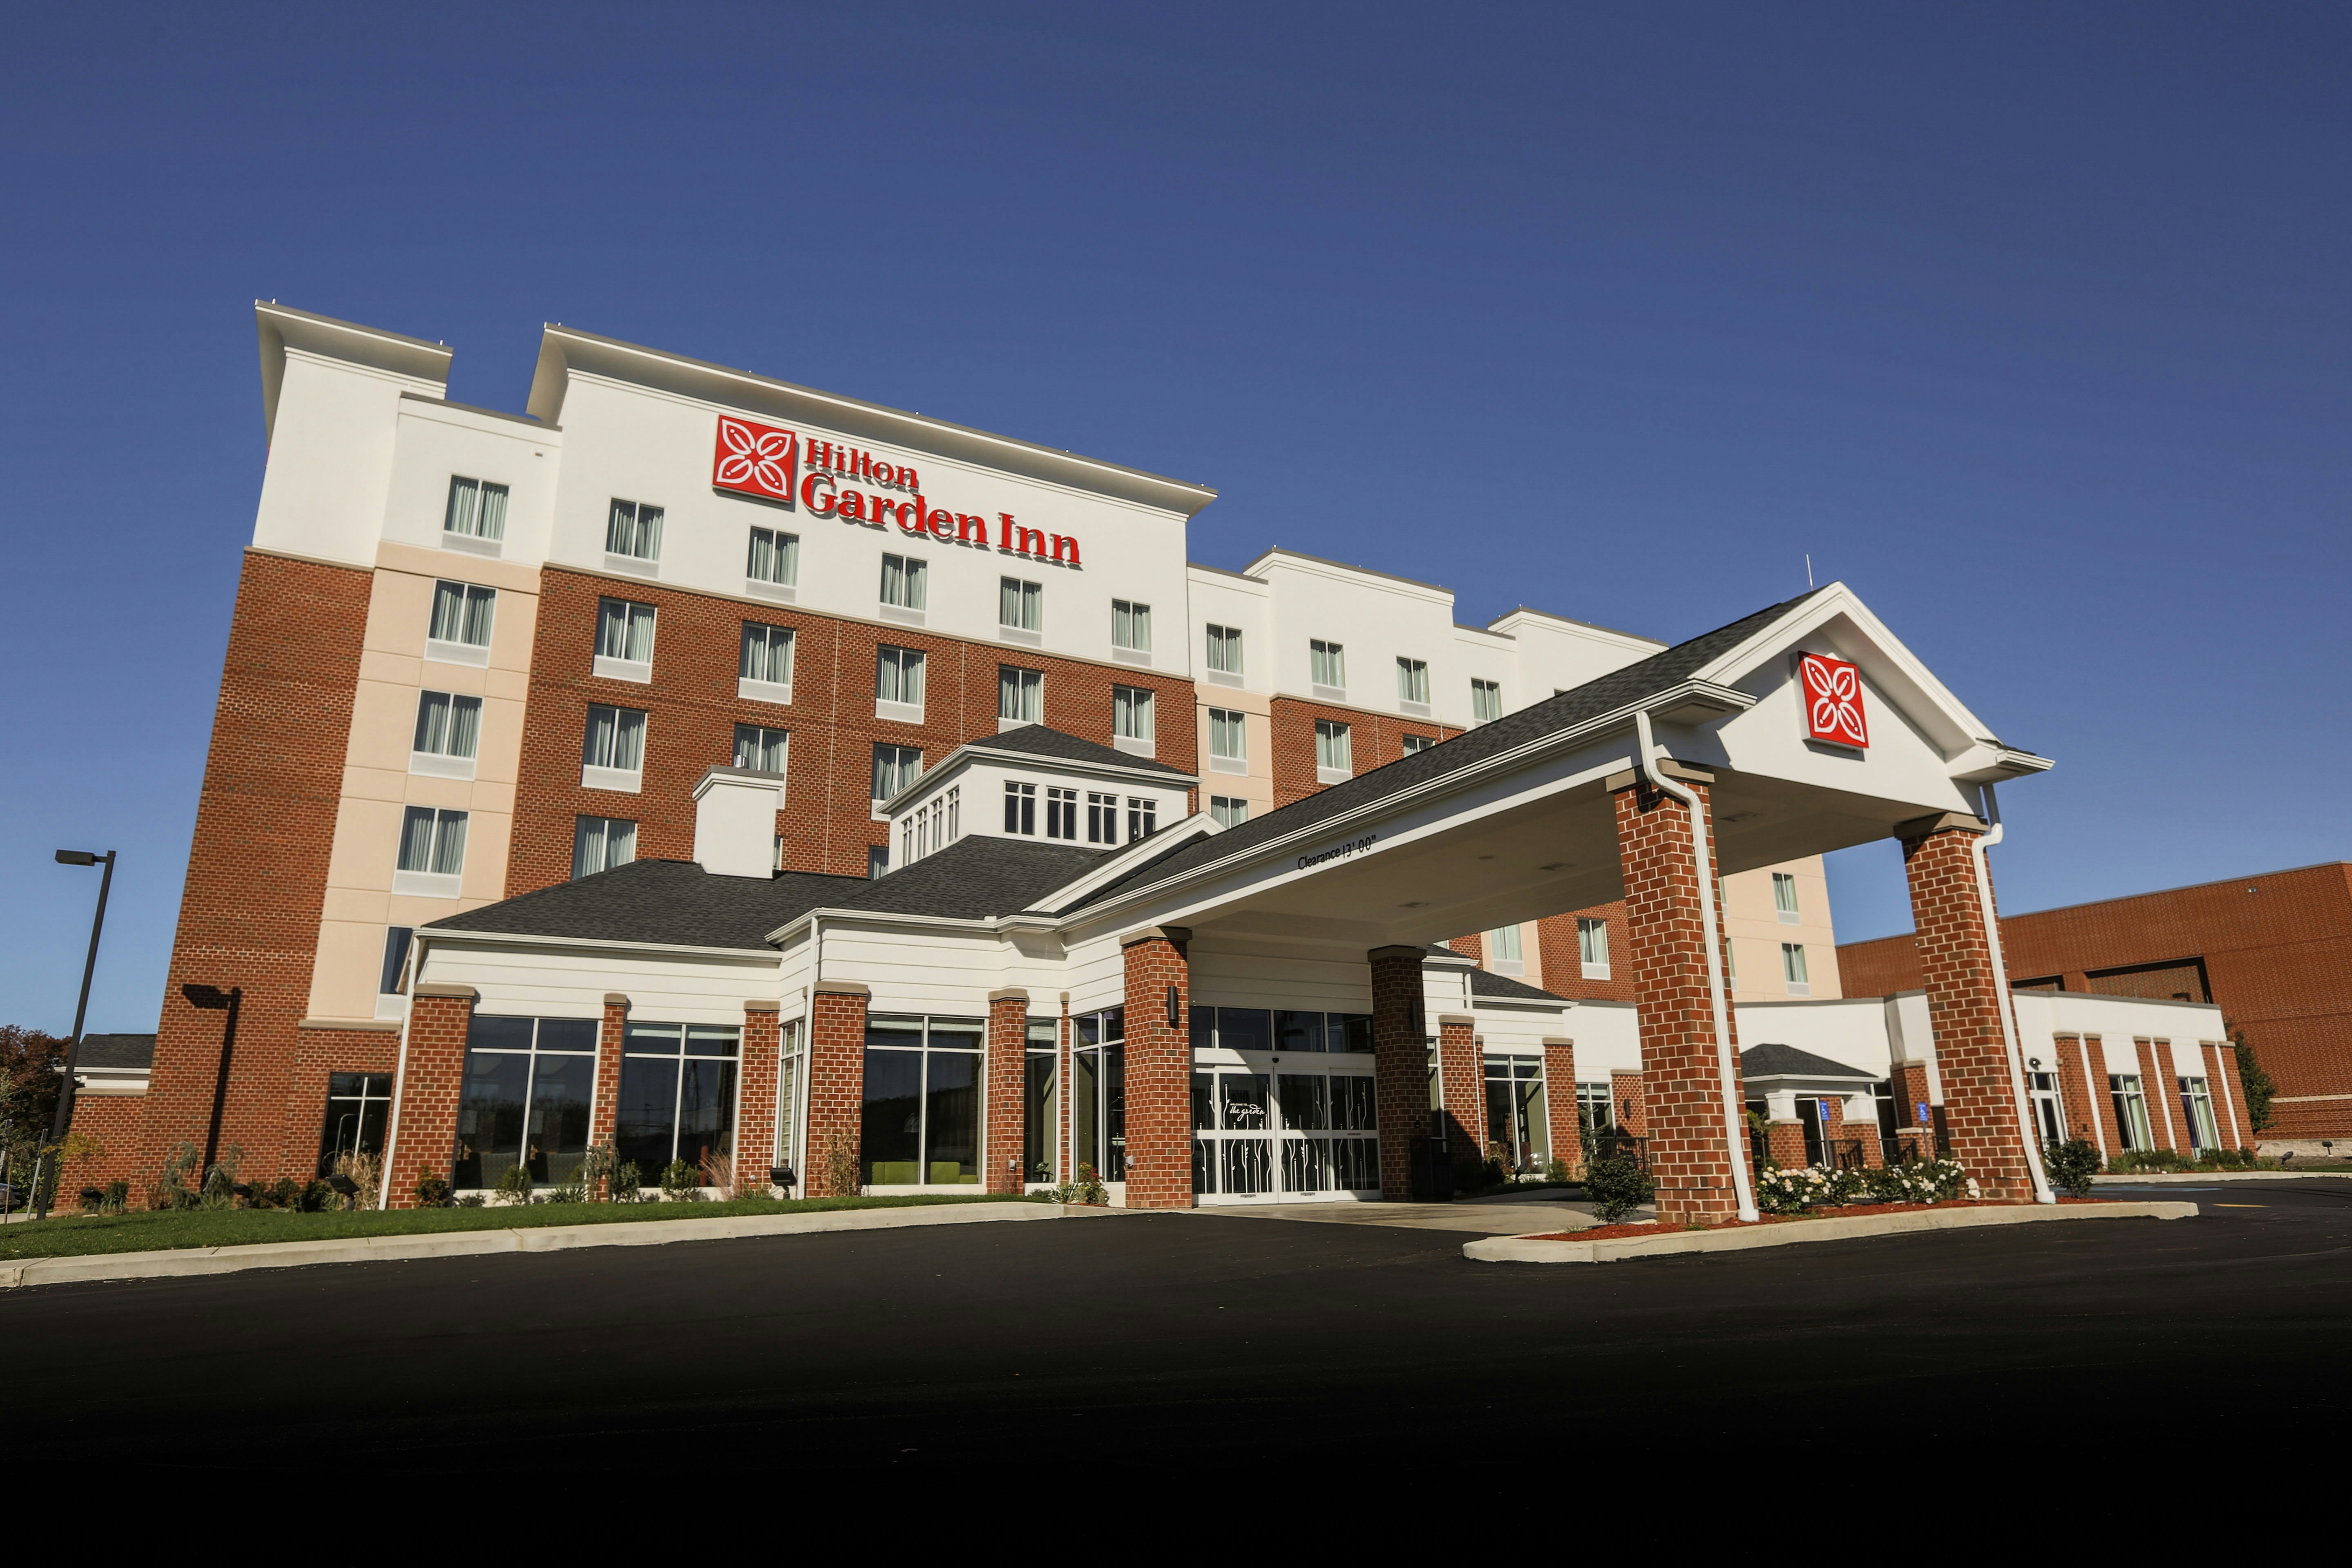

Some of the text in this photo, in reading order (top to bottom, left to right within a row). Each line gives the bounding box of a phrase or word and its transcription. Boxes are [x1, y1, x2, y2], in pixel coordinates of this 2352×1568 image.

[804, 437, 918, 489] Hilton
[800, 472, 1082, 565] Garden Inn
[1298, 848, 1341, 870] Clearance
[1229, 1106, 1241, 1114] the
